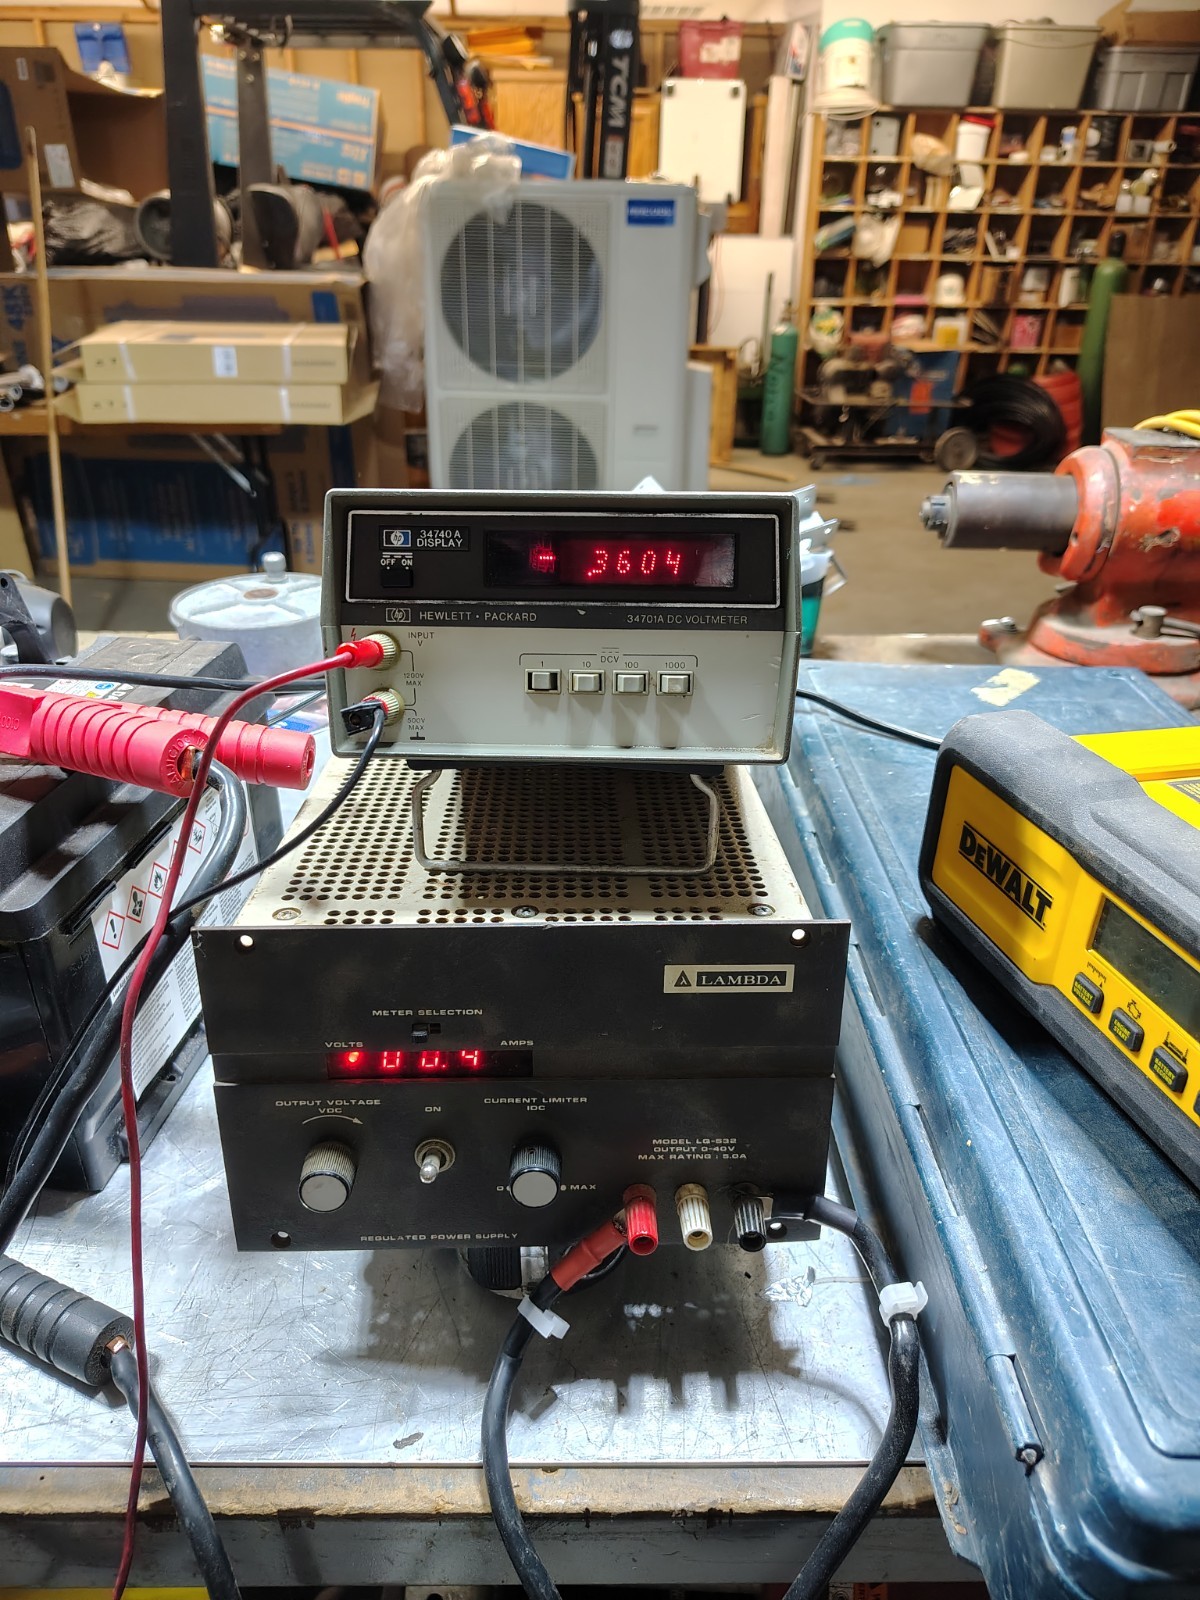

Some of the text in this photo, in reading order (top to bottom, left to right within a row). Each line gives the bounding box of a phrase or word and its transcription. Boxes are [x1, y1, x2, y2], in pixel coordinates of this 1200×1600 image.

[608, 55, 630, 129] TCM
[416, 538, 463, 547] DISPLAY
[380, 558, 413, 566] OFF ON
[419, 611, 537, 622] HEWLETT PACKARD
[626, 614, 748, 625] 34701A DC VOLTMETER
[407, 631, 435, 639] INPUT
[600, 655, 620, 664] DCV
[664, 661, 686, 669] 1000
[701, 975, 781, 985] LAMBDA
[1114, 1019, 1131, 1037] ENGINE
[1113, 1025, 1128, 1042] START
[1154, 1057, 1175, 1080] BATTERY
[275, 1098, 381, 1107] OUTPUT VOLTAGE
[542, 1096, 588, 1104] LIMITER
[360, 1232, 519, 1242] REGULATED POWER SUPPLY
